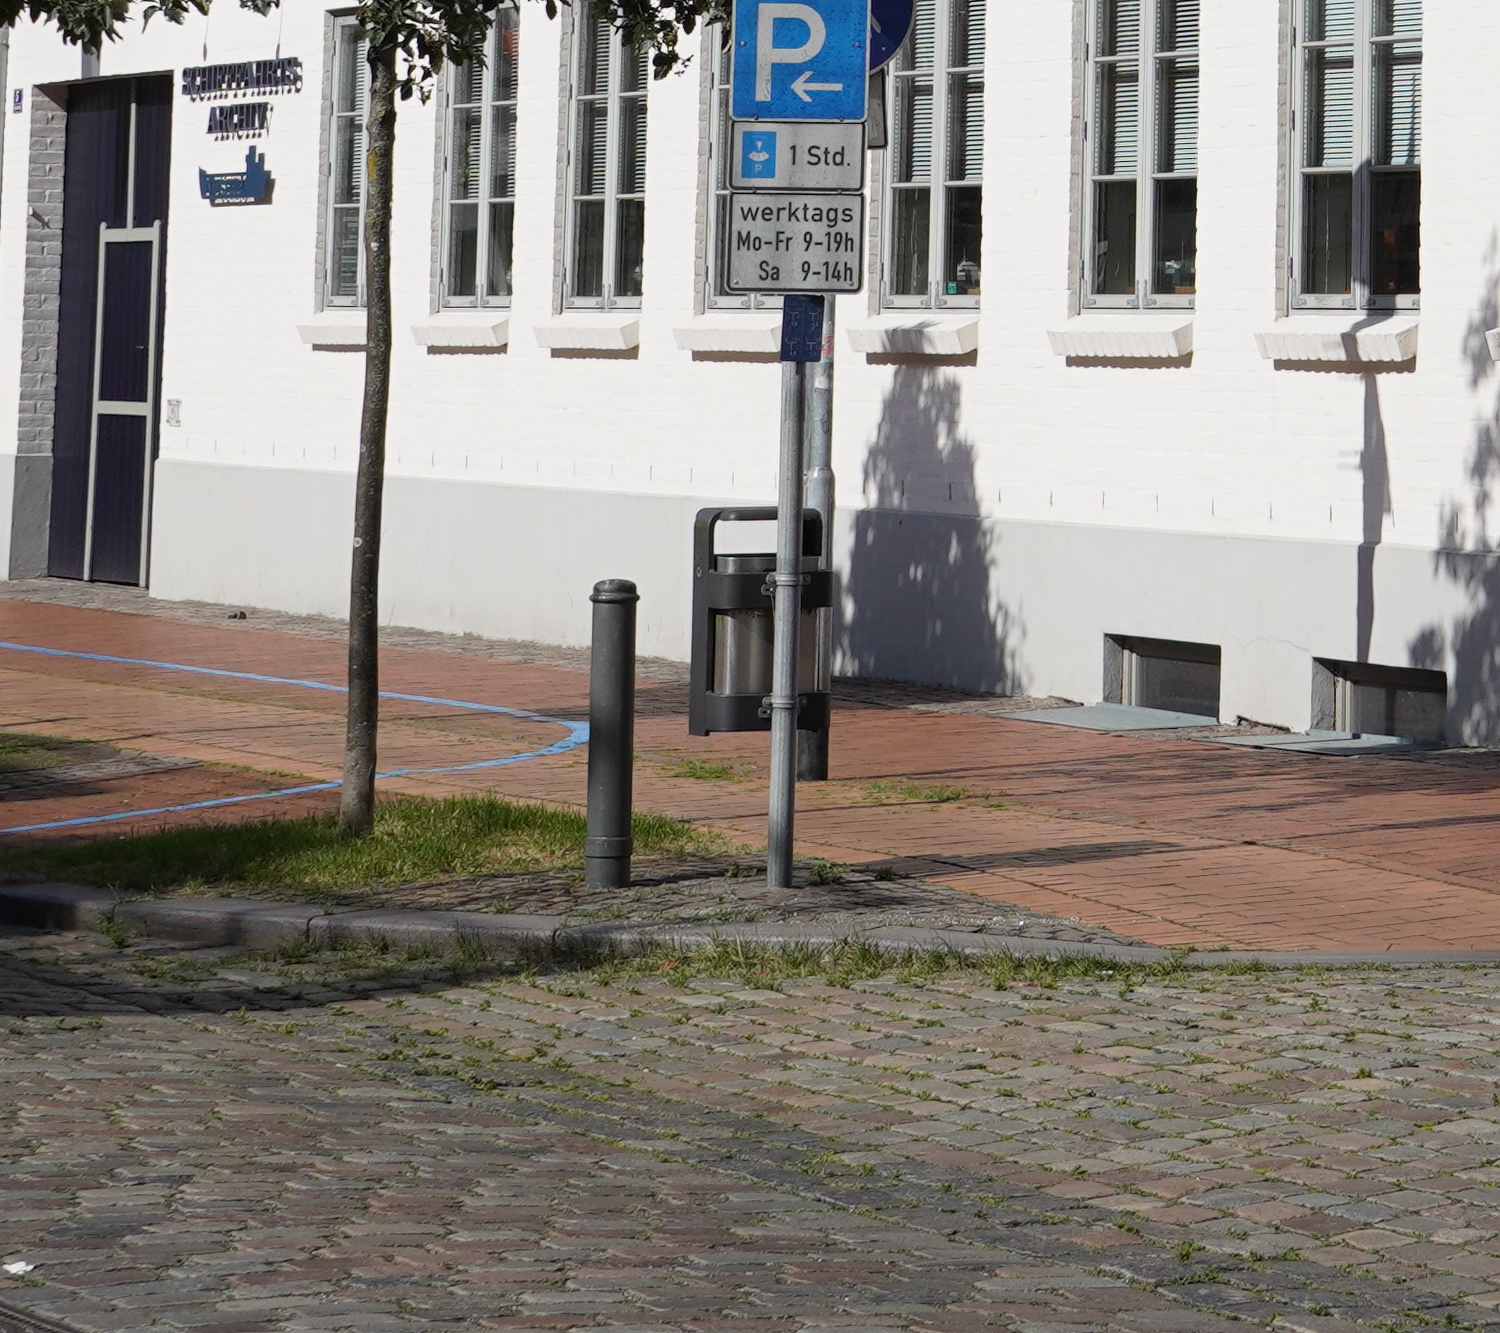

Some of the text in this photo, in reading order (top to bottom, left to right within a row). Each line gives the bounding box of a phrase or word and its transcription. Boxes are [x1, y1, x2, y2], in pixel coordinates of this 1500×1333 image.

[755, 2, 827, 102] P
[206, 101, 270, 135] ARCHIV
[789, 144, 851, 167] 1 Std.
[739, 201, 854, 228] werktags
[736, 230, 855, 253] Mo-Fr 9-19h
[758, 260, 854, 283] Sa 9-14h
